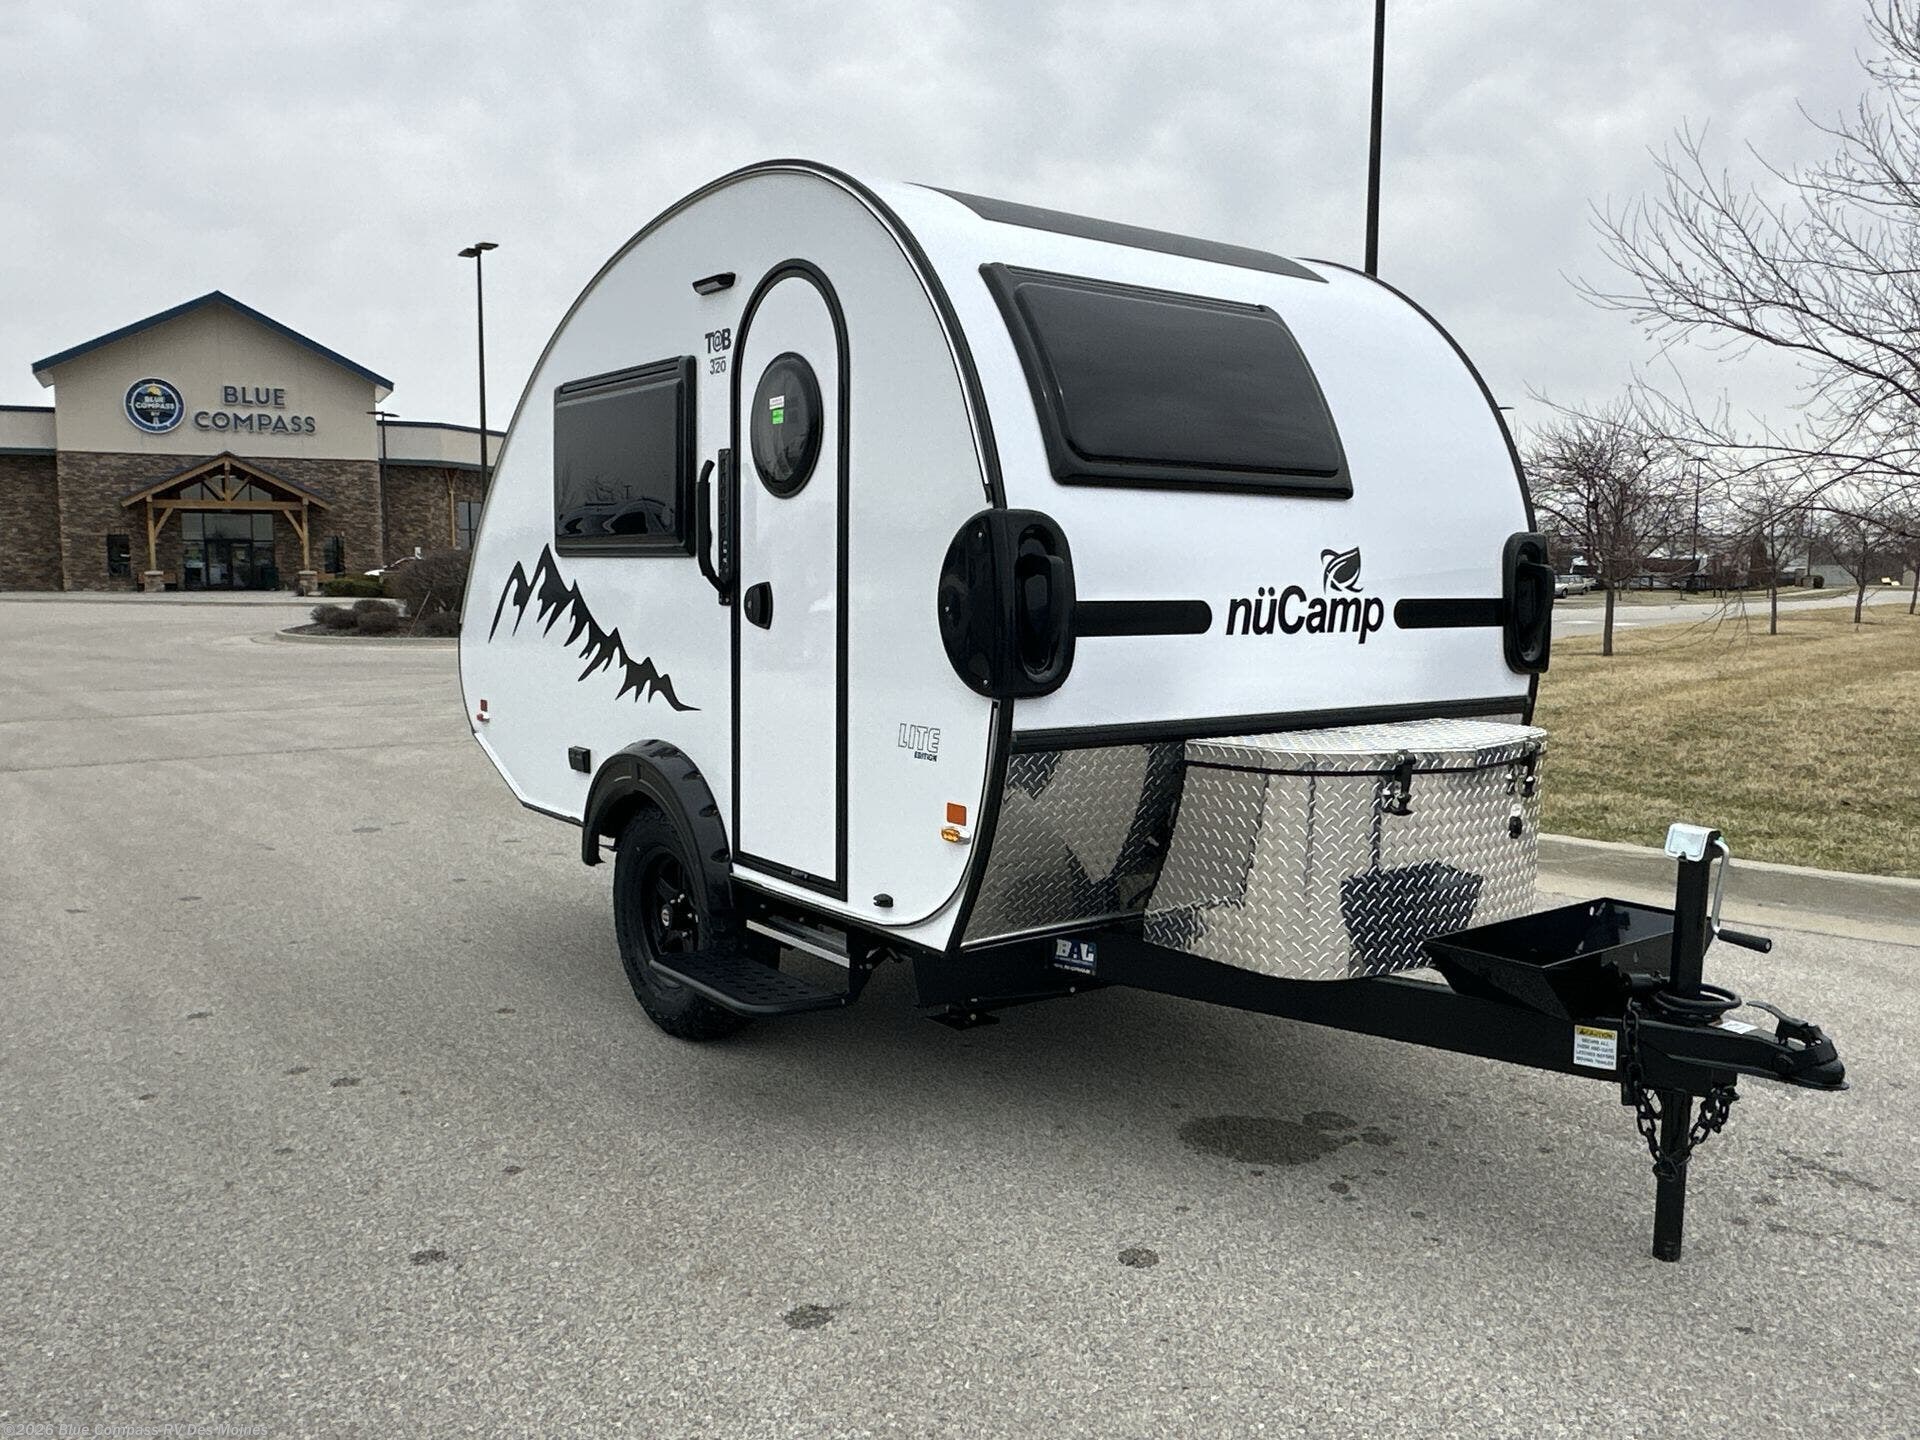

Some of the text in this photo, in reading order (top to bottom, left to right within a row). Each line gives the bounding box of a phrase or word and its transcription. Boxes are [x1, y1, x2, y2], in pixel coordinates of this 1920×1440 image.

[705, 328, 732, 353] T@B
[709, 359, 726, 375] 320
[223, 386, 286, 406] BLUE
[194, 411, 316, 433] COMPASS
[1225, 585, 1385, 645] nüCamp
[898, 723, 941, 754] LITE
